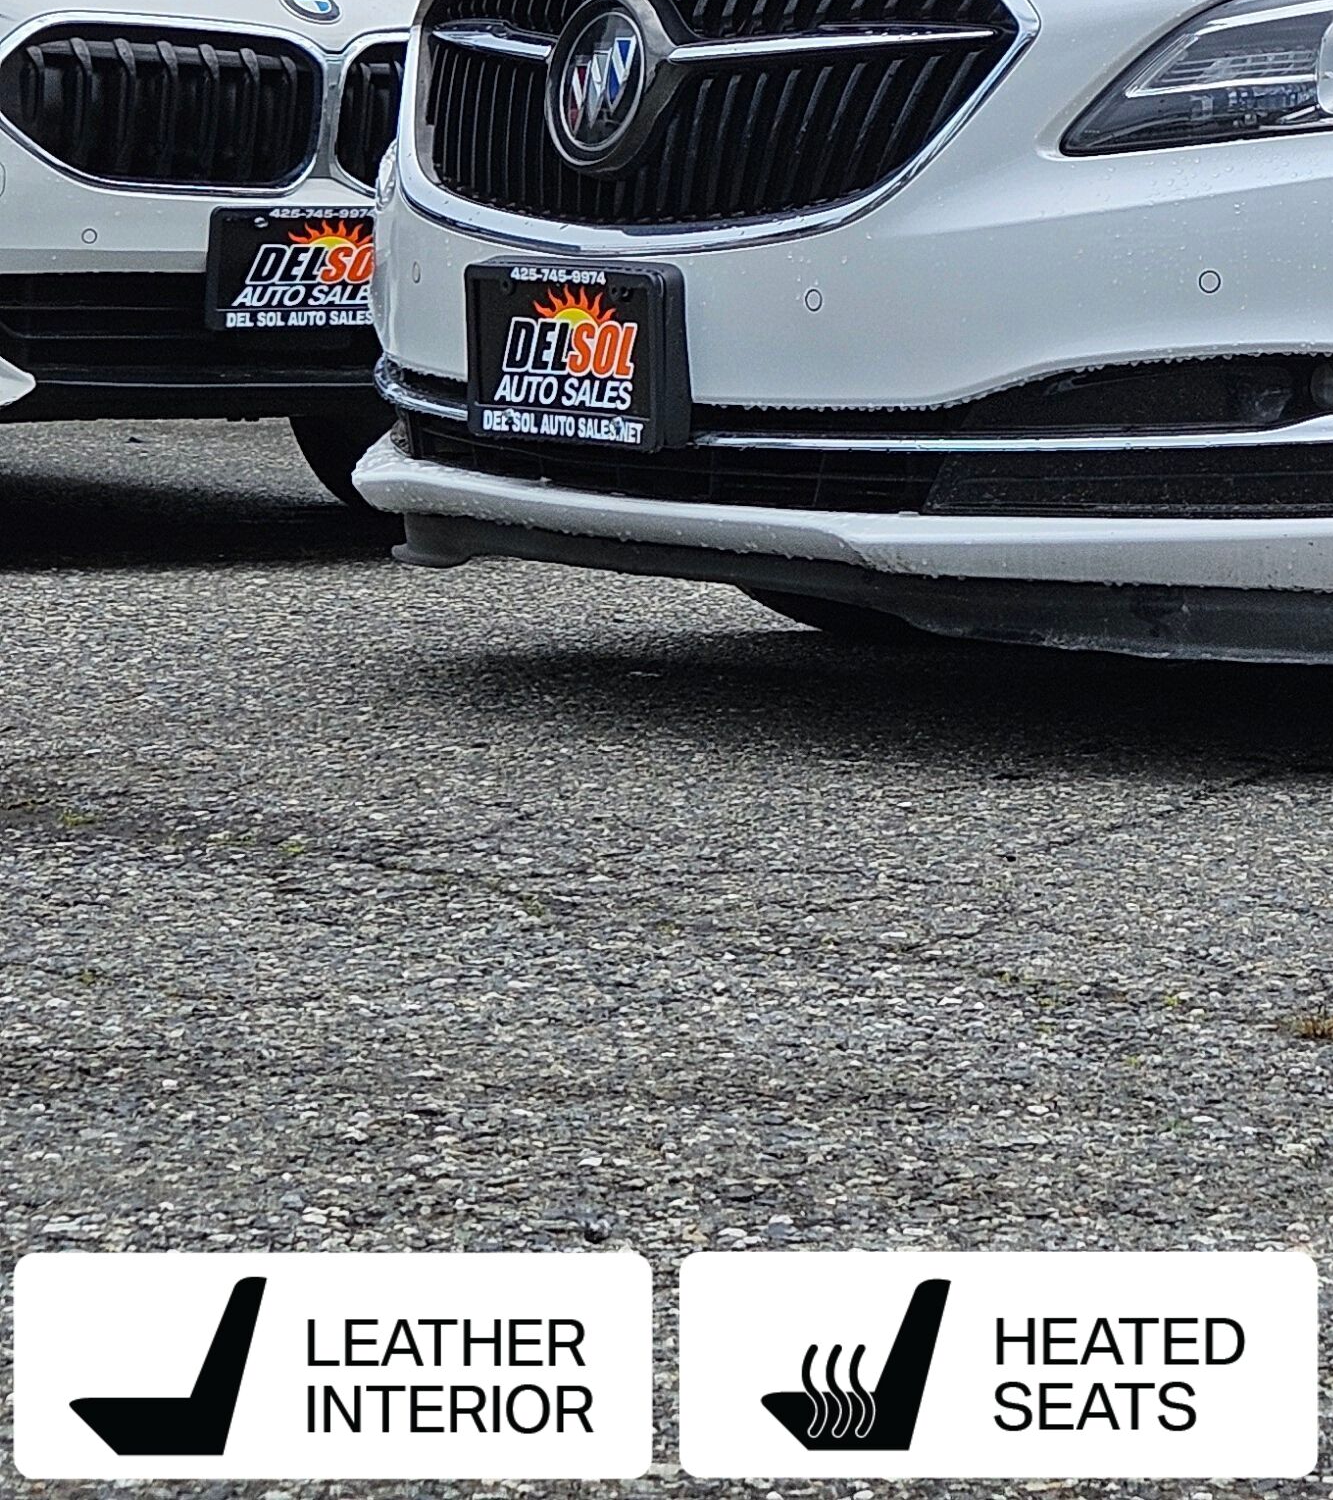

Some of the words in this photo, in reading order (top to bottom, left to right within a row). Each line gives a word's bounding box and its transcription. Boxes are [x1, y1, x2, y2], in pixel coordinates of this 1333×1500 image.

[245, 244, 376, 285] DELSO
[510, 266, 607, 286] 425-745-9974
[232, 285, 305, 307] AUTO
[308, 285, 371, 306] SALE
[226, 312, 254, 328] DEL
[256, 312, 285, 327] SOL
[287, 311, 326, 327] AUTO
[494, 374, 558, 405] AUTO
[562, 379, 633, 411] SALES
[511, 413, 537, 434] SOL
[540, 414, 575, 437] AUTO
